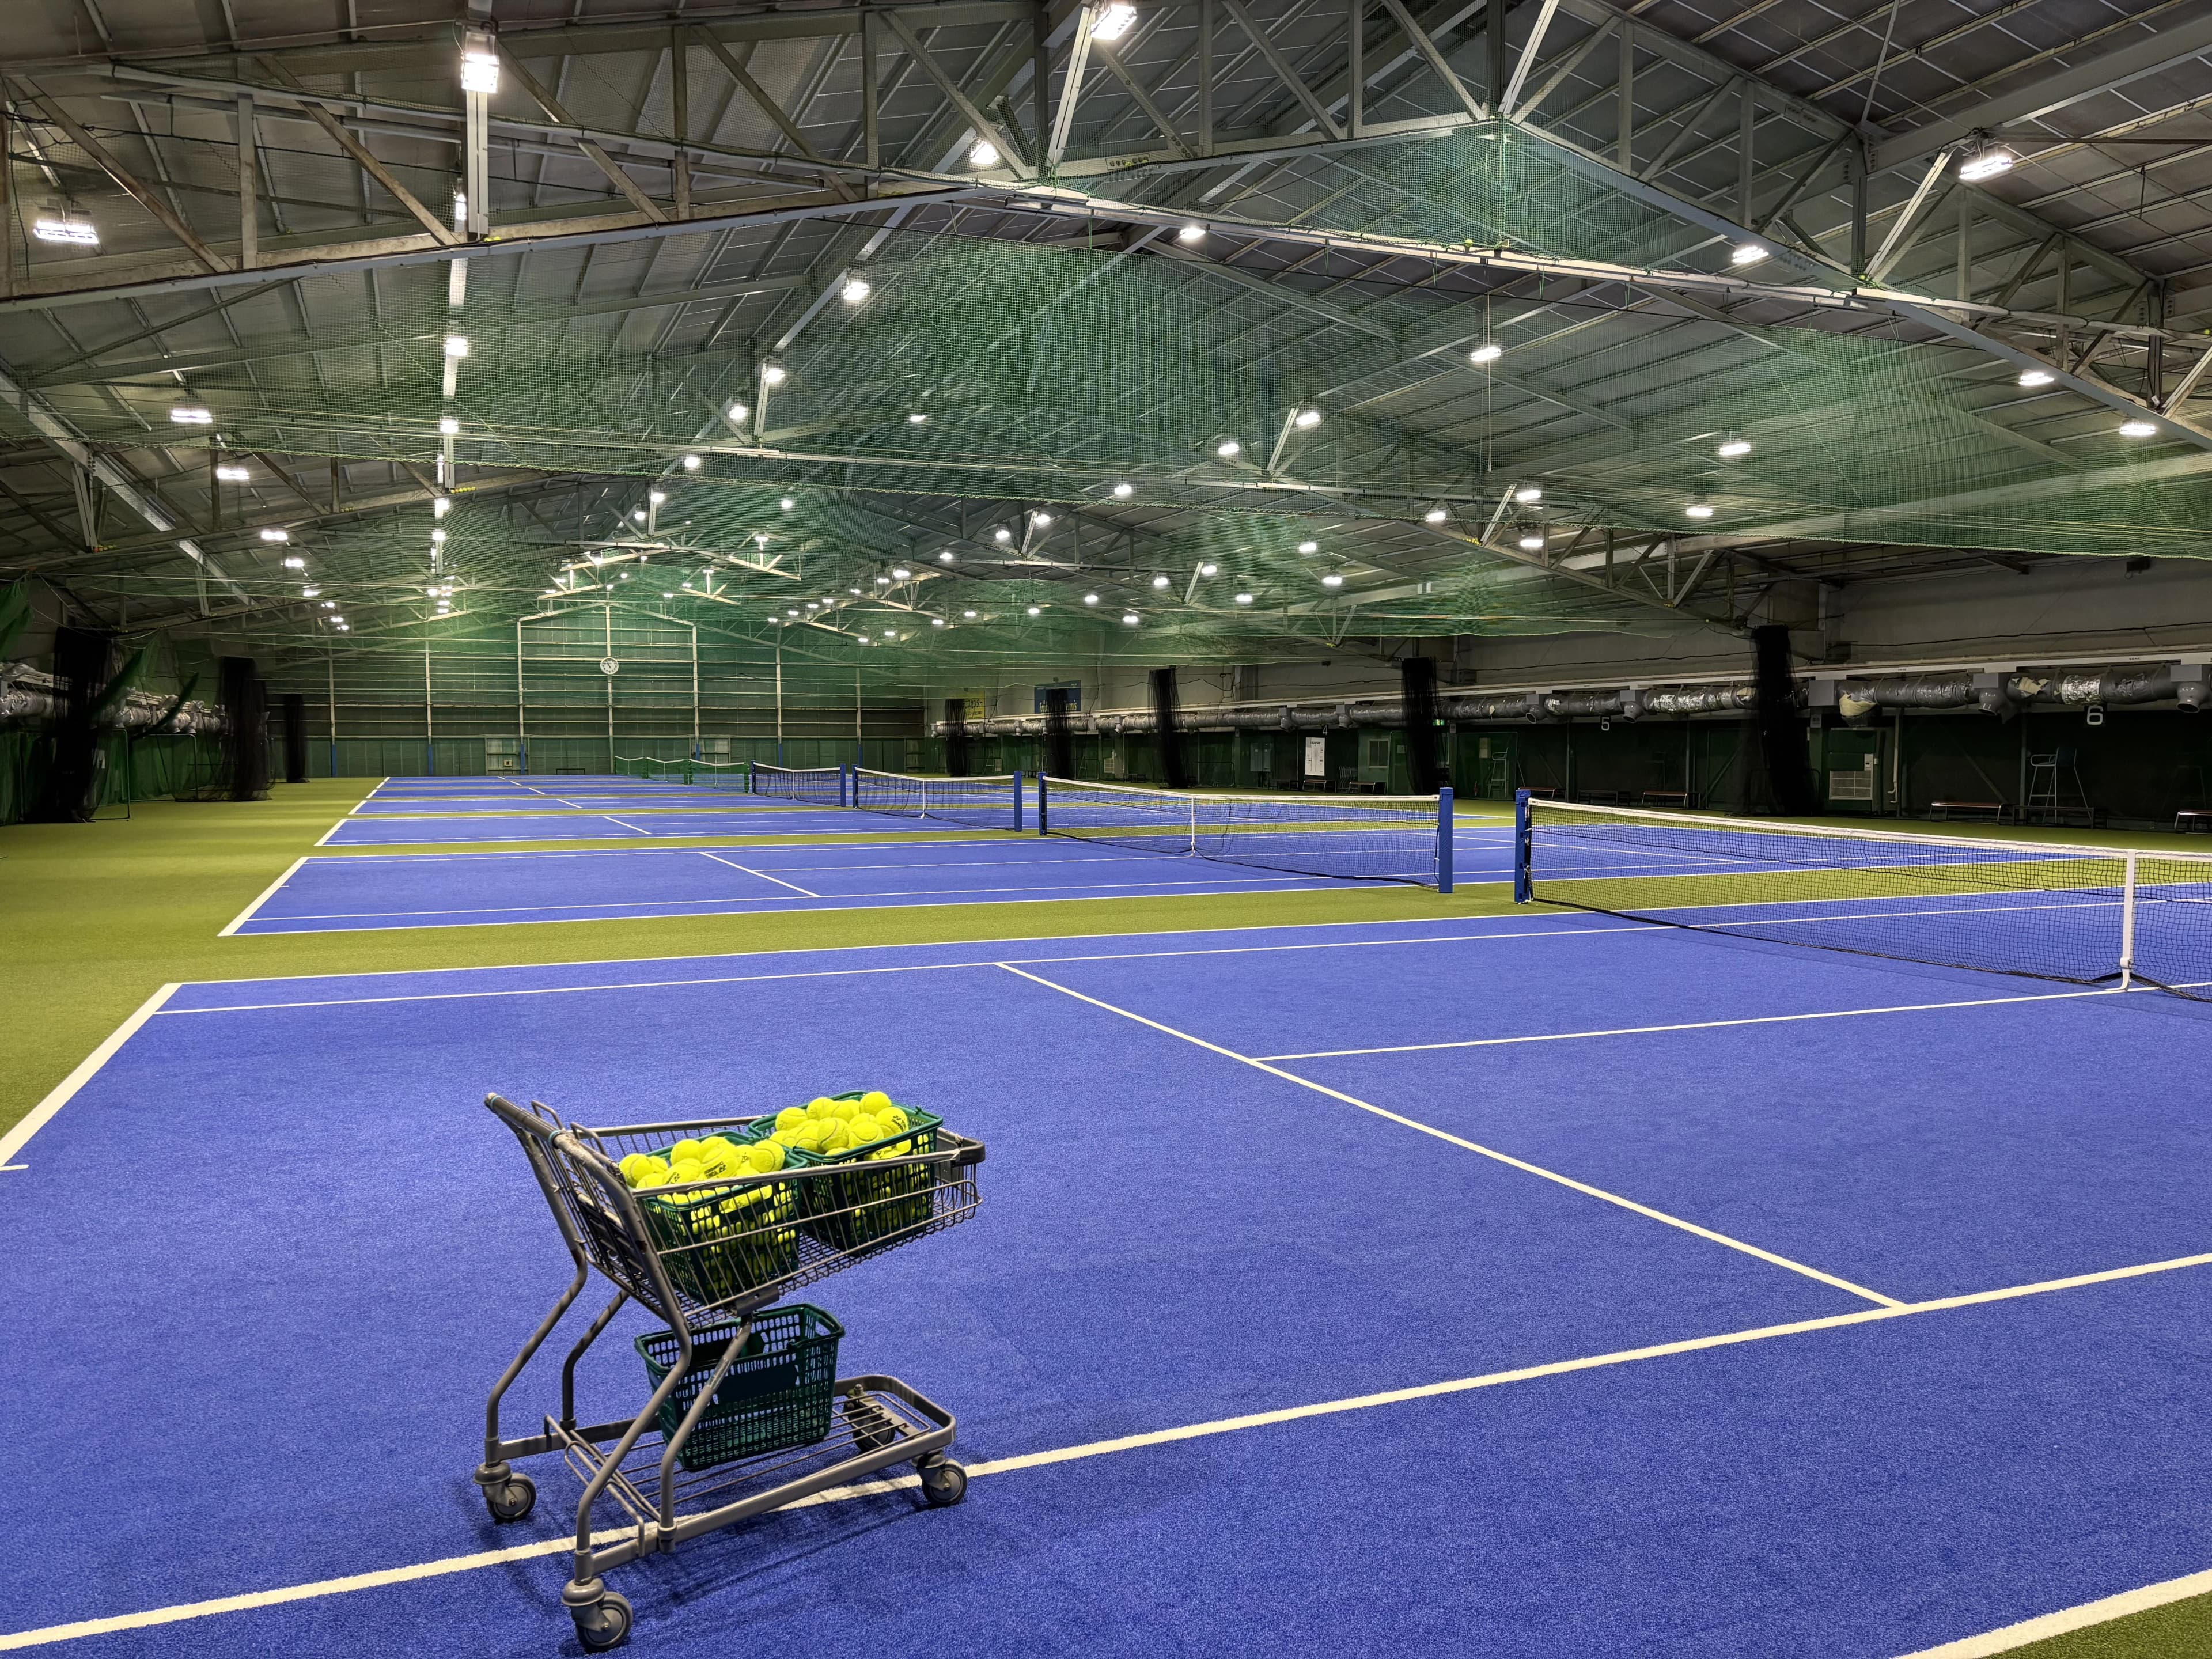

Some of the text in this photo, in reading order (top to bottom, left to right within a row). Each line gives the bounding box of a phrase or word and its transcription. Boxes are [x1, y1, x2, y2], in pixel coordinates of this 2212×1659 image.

[2086, 705, 2104, 725] 6
[1322, 725, 1328, 736] 4
[1601, 716, 1609, 731] 5
